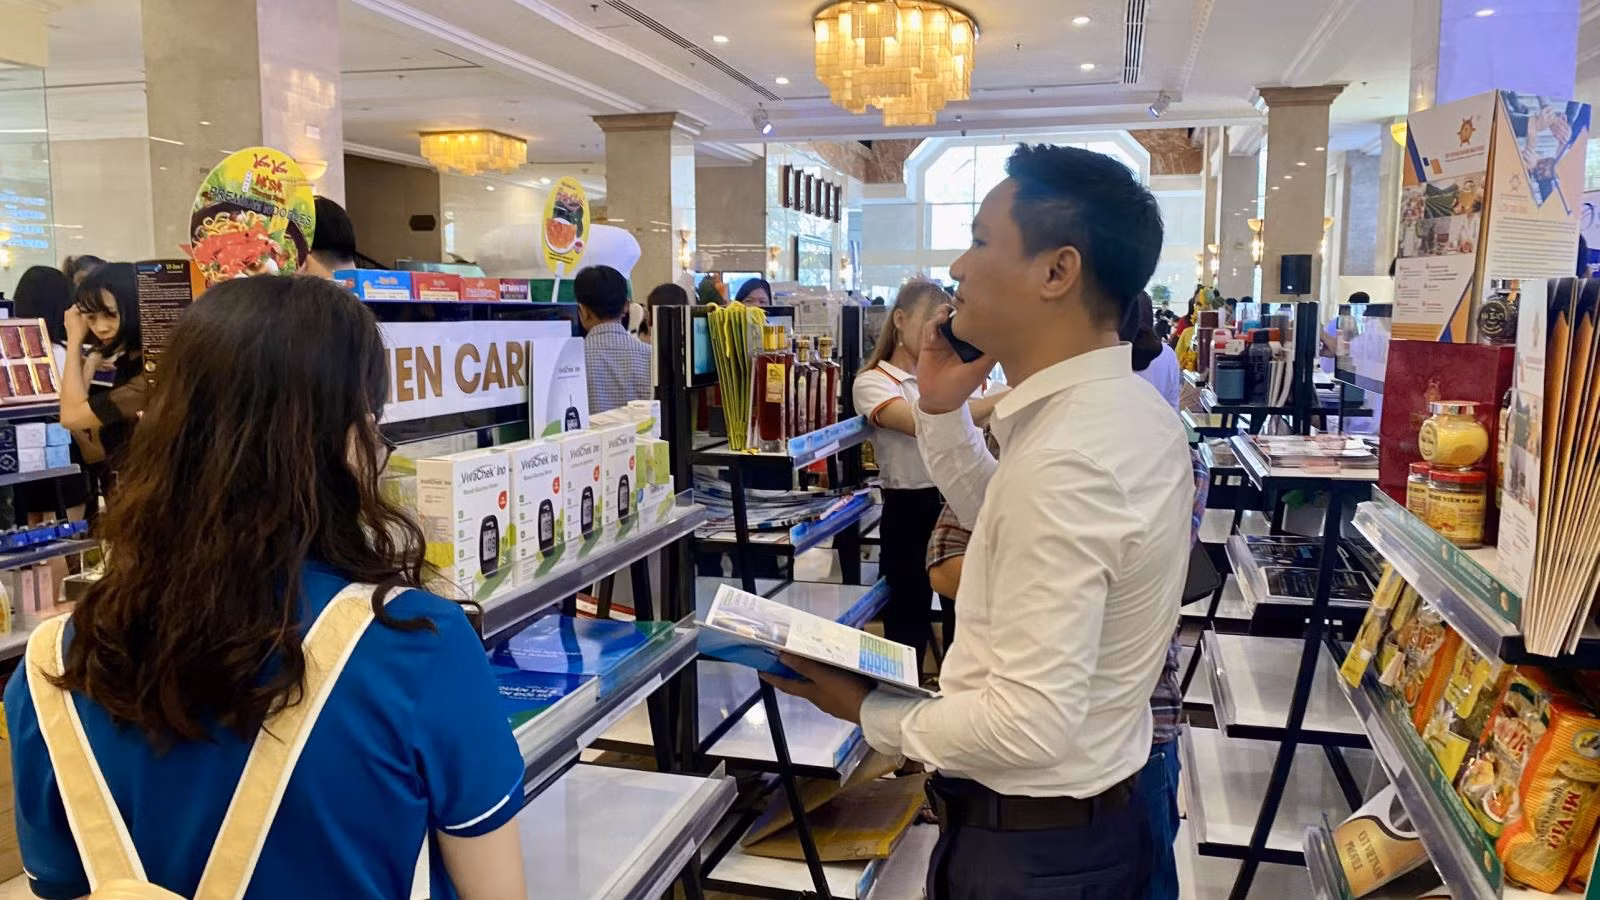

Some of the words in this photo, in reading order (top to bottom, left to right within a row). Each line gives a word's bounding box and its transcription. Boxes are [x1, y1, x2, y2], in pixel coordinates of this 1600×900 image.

[385, 346, 443, 404] EN
[454, 340, 531, 394] CAR
[460, 464, 495, 484] VivaChek
